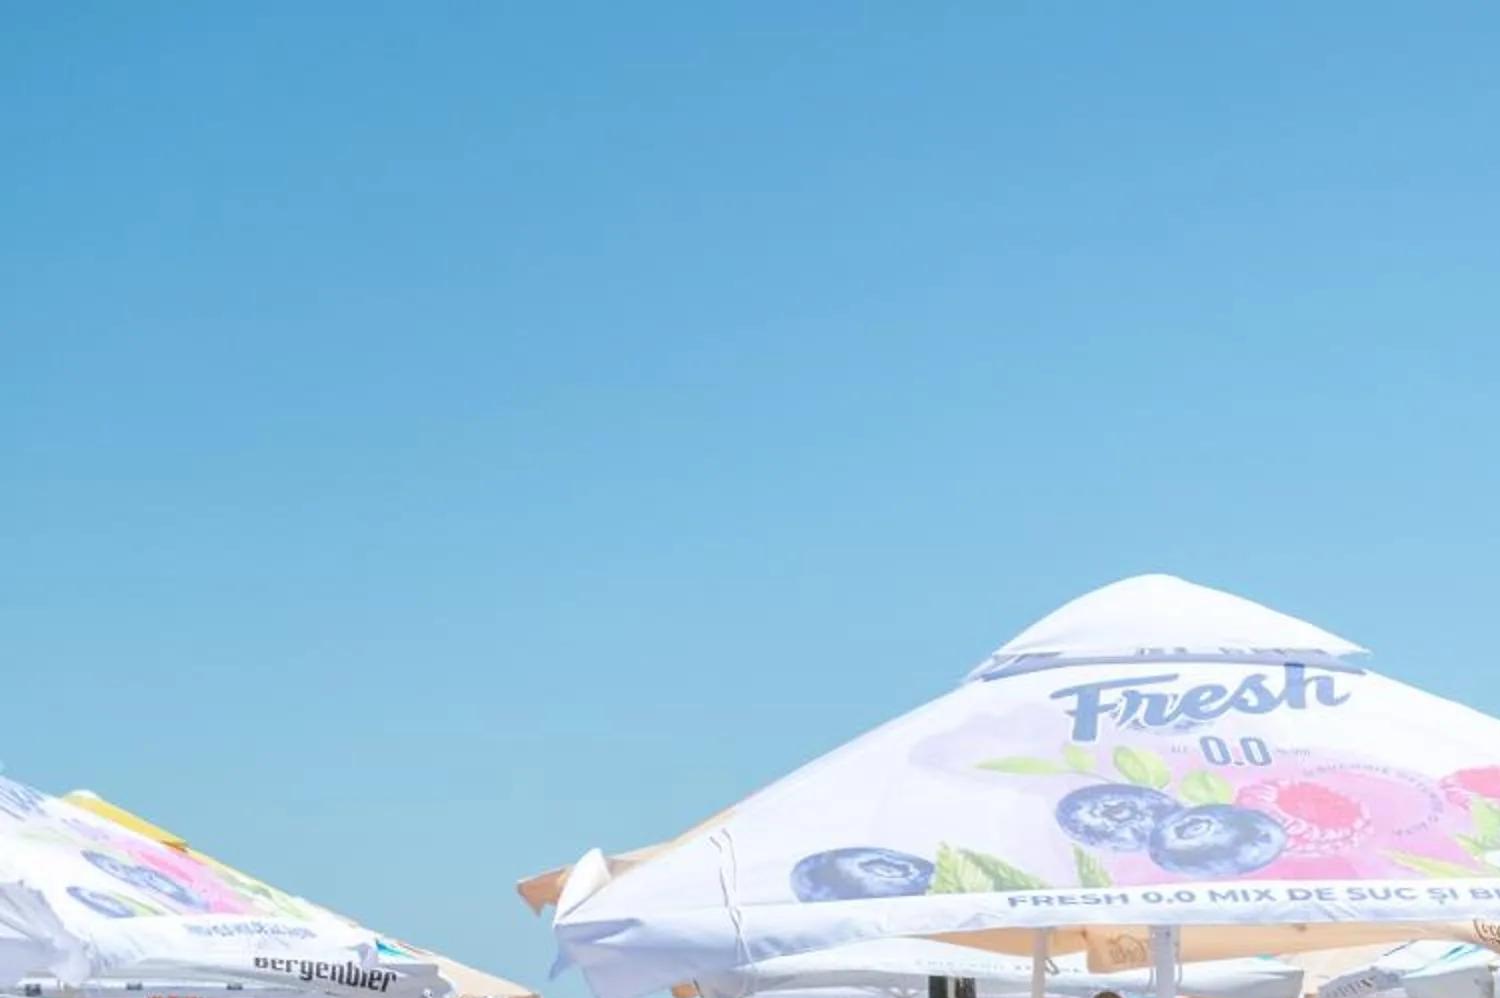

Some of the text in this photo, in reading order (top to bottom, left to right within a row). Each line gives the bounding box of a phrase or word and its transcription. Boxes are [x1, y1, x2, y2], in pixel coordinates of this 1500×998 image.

[1048, 661, 1351, 742] Fresh
[1199, 736, 1273, 767] 0.0
[1008, 892, 1130, 909] FRESH
[1141, 889, 1197, 904] 0.0
[1208, 888, 1278, 904] MIX
[1287, 887, 1338, 901] DE
[1346, 886, 1418, 901] SUC
